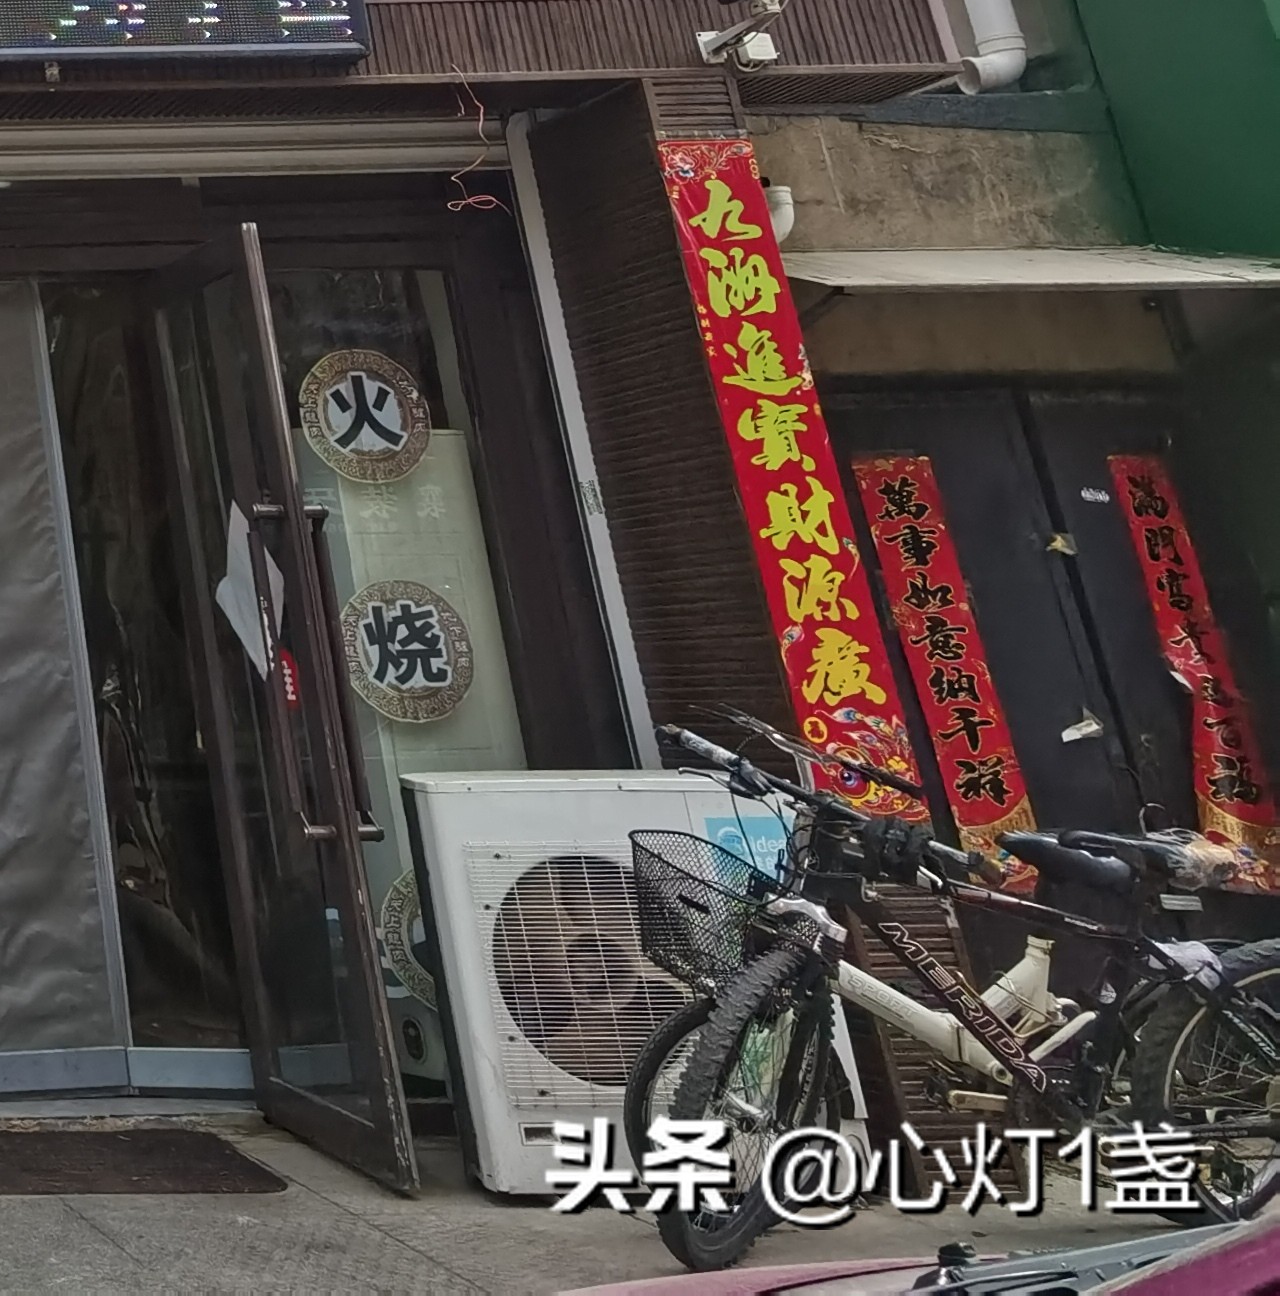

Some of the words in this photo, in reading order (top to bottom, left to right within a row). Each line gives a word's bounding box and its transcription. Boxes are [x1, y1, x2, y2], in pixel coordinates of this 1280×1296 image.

[329, 375, 404, 449] 火
[362, 603, 449, 686] 烧
[878, 921, 1047, 1095] MERIDA
